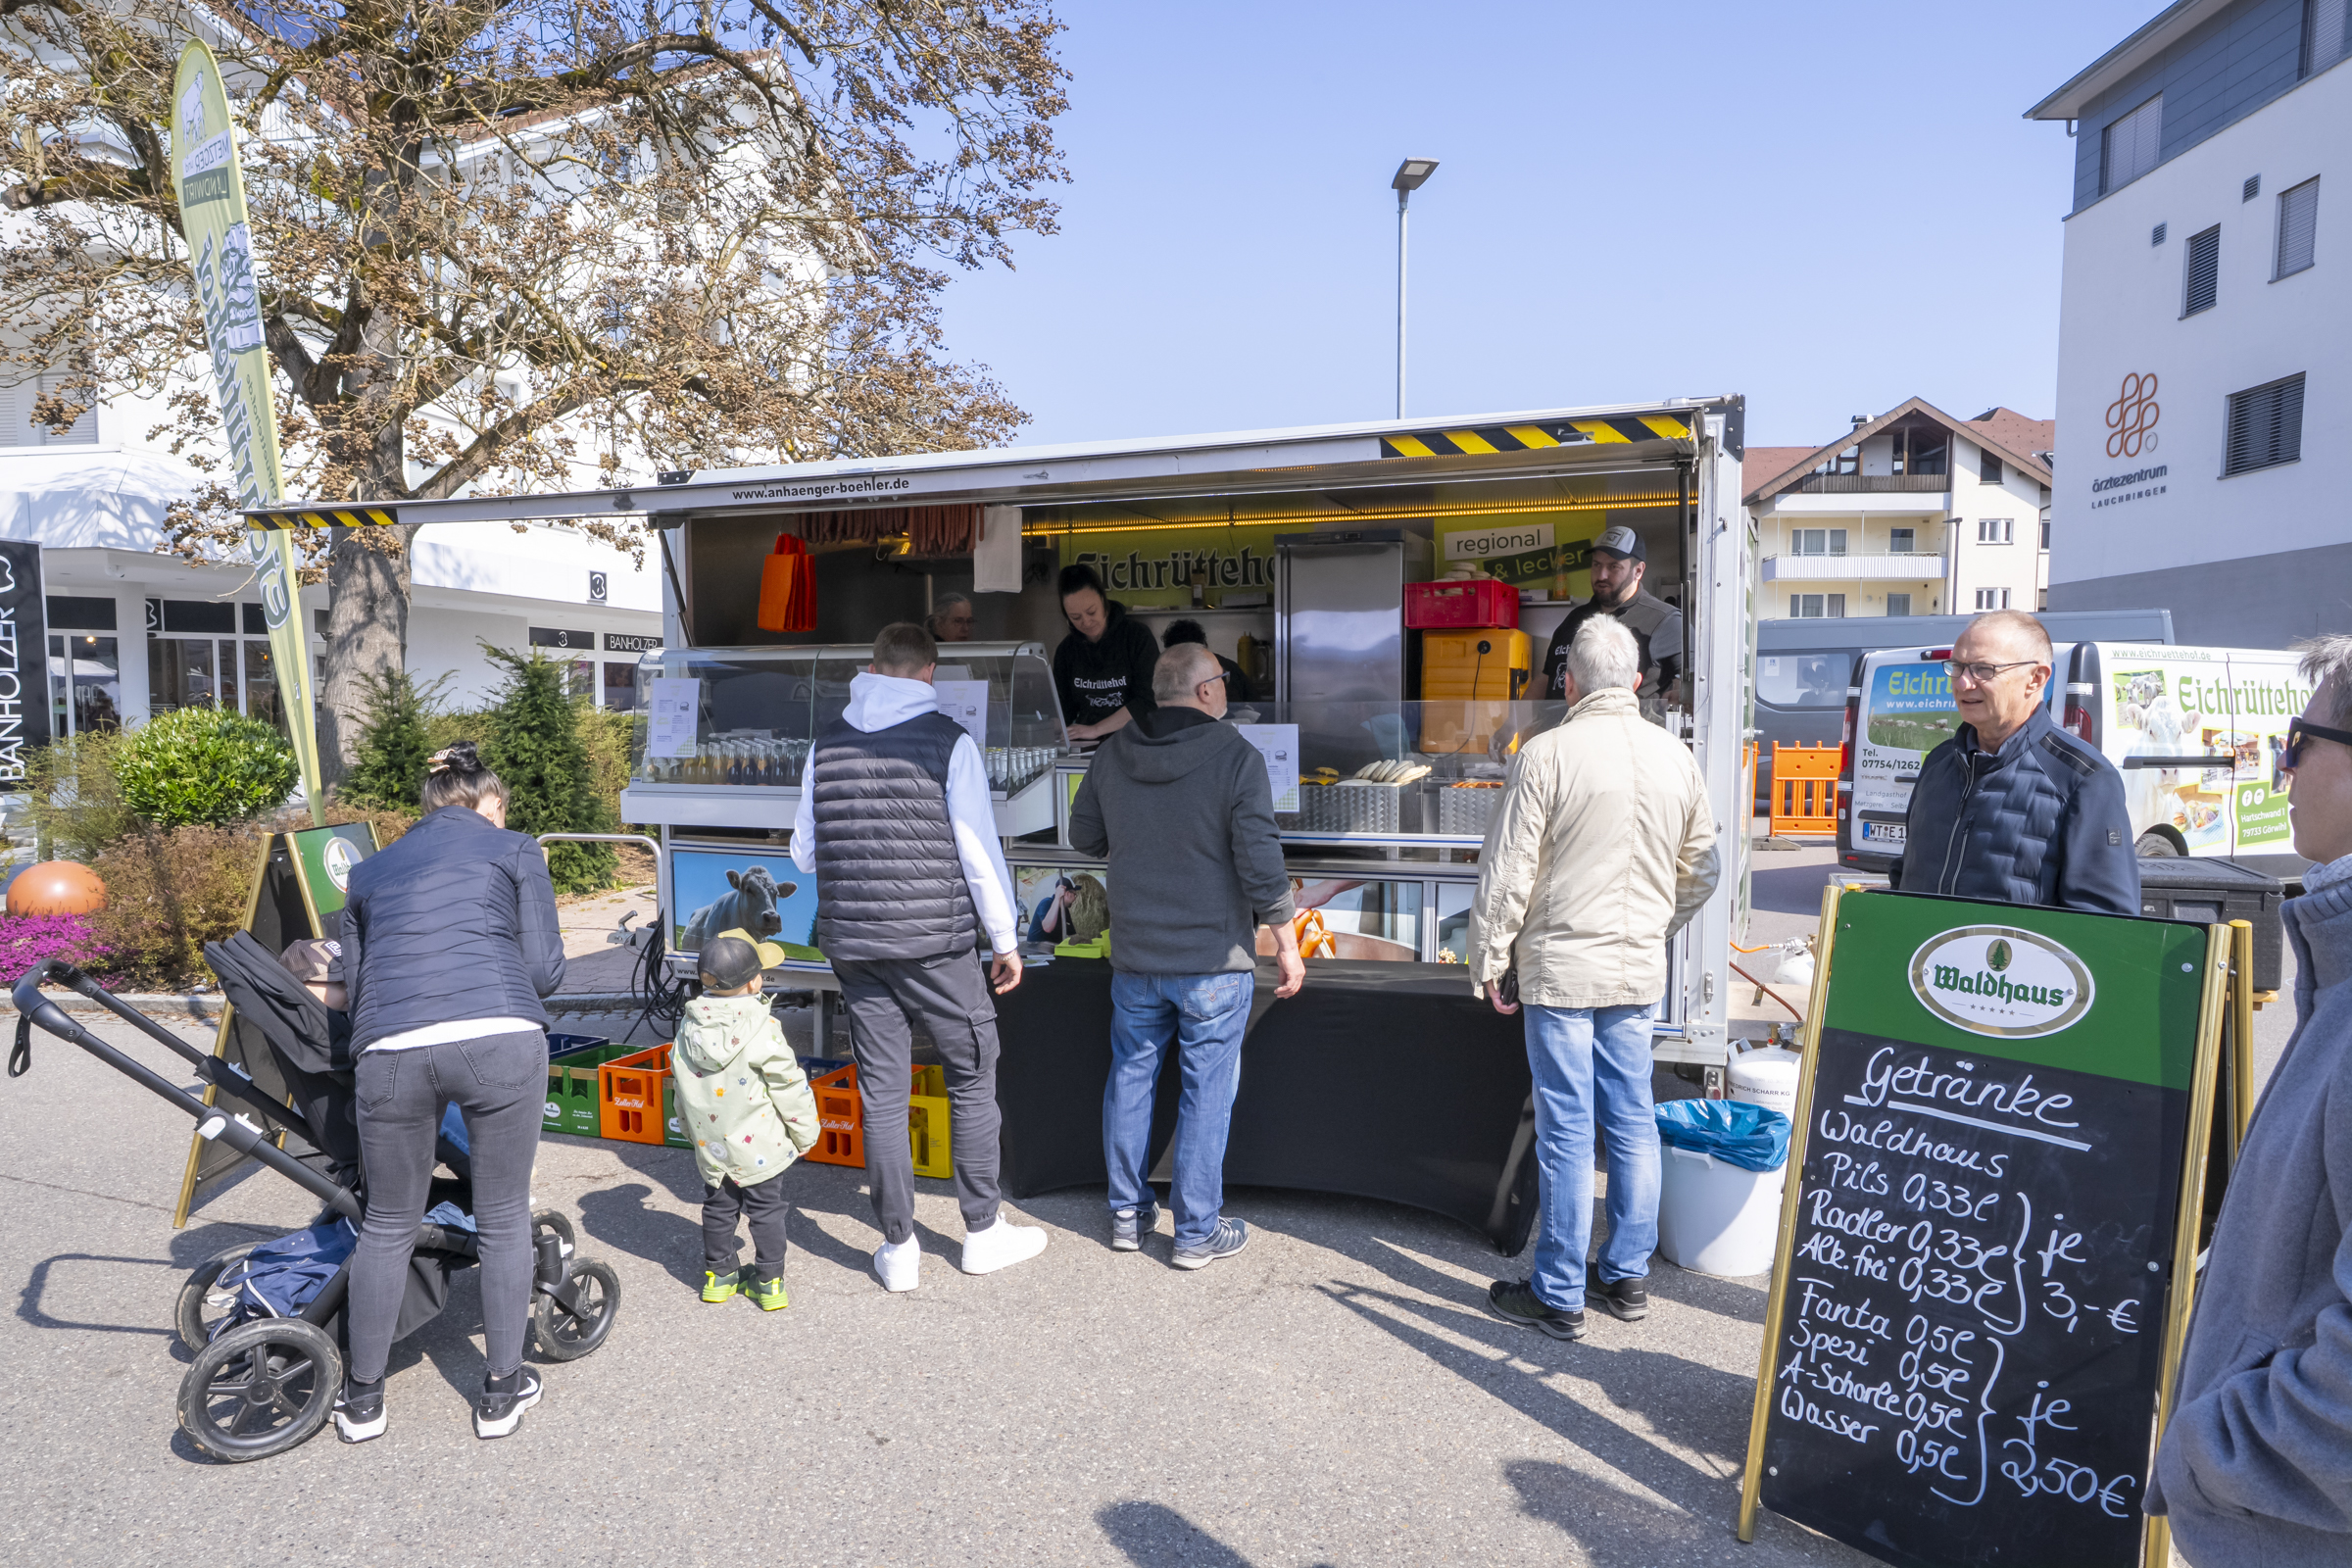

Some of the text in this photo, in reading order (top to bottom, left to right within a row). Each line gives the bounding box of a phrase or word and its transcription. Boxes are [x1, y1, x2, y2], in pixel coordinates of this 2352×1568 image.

[732, 477, 909, 500] www.anhaenger-boehler.de
[2091, 485, 2167, 510] LAUCHRINGEN
[1456, 529, 1542, 555] regional
[1494, 563, 1508, 580] &
[610, 635, 658, 650] BANHOLZER
[2112, 648, 2212, 661] www.eichruettehof.de
[2179, 676, 2314, 715] Eichrütteho
[1861, 759, 1921, 770] 07754/1262
[1862, 748, 1879, 758] Tel.
[1865, 790, 1907, 799] Landgasthof
[2240, 808, 2281, 823] Hartschwand
[2242, 822, 2287, 838] 79733 Görwihl
[1934, 963, 2066, 1007] Waldhaus
[1751, 1087, 1780, 1097] SCHARR
[1861, 1047, 2080, 1128] Getränke
[1820, 1108, 2009, 1179] Waldhaus
[1823, 1152, 1889, 1196] Pils
[1807, 1189, 1908, 1243] Radler
[1796, 1277, 1892, 1341] Fanta
[1788, 1318, 1876, 1364] Spezi
[1781, 1385, 1880, 1445] Wasser
